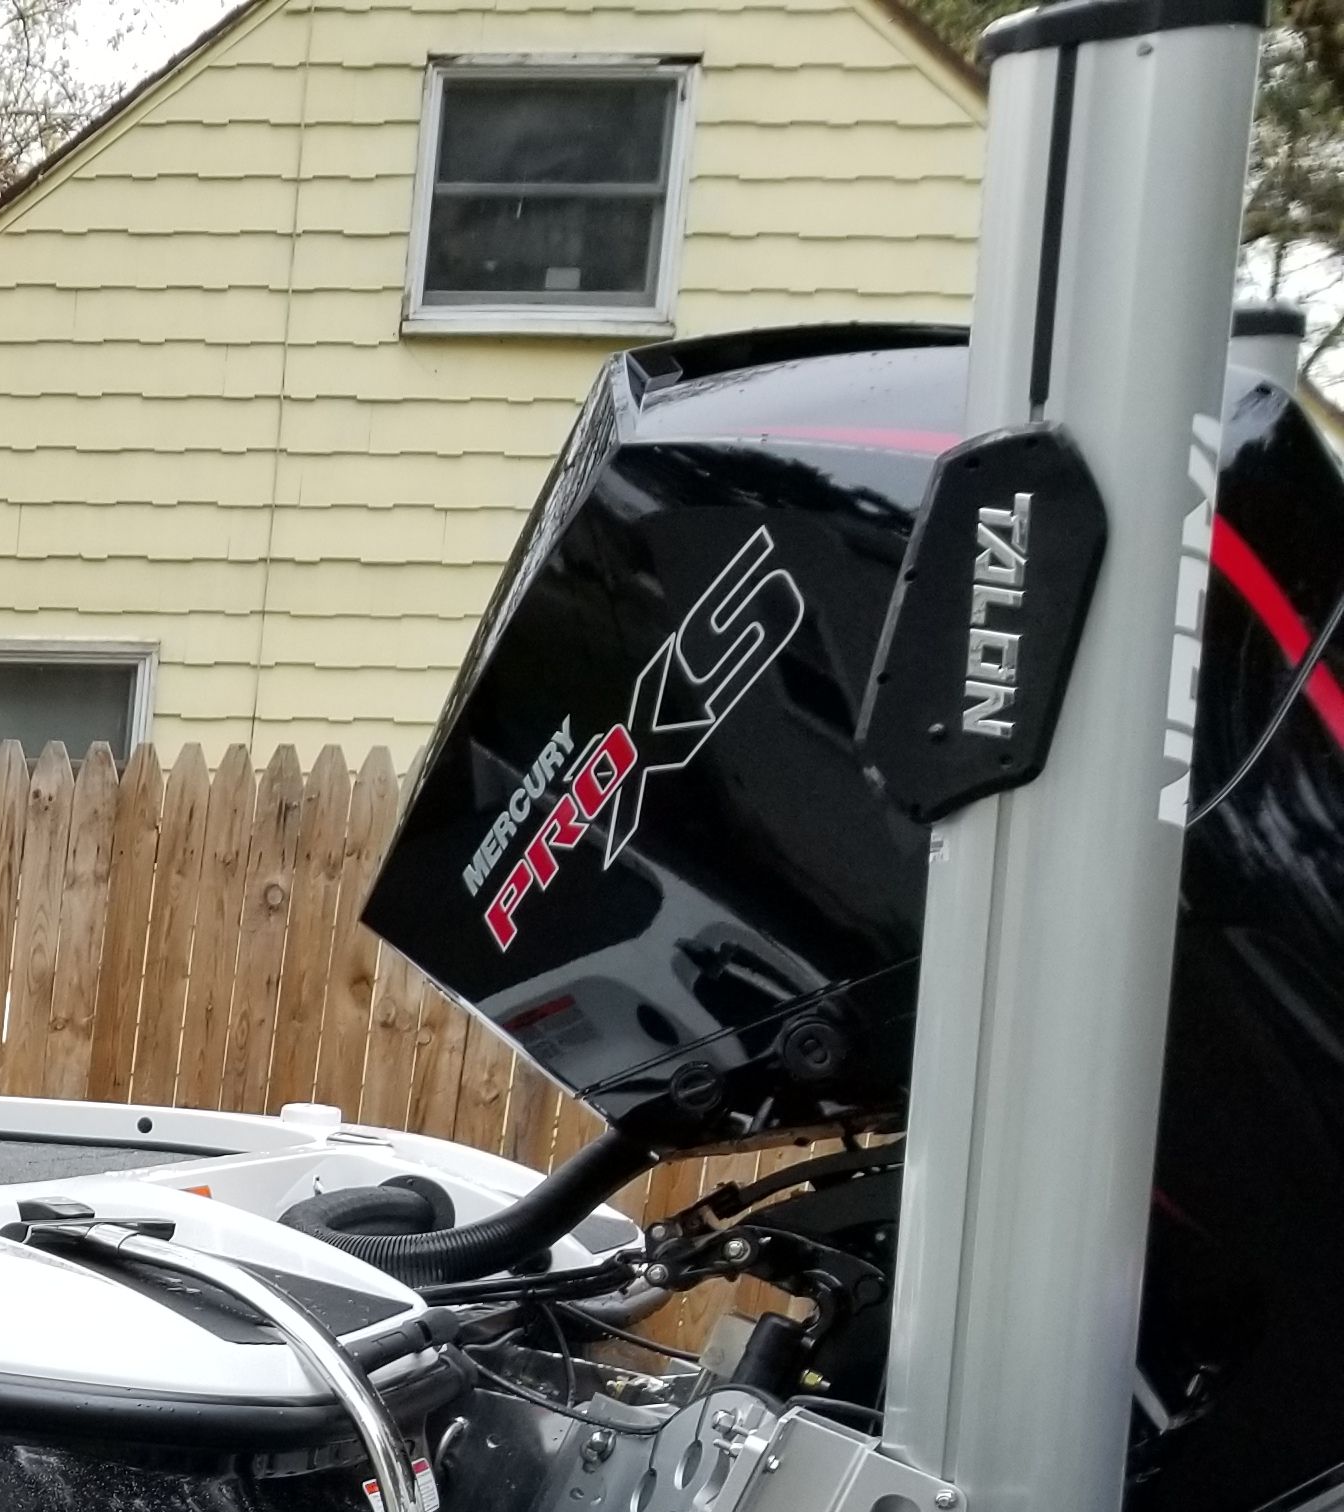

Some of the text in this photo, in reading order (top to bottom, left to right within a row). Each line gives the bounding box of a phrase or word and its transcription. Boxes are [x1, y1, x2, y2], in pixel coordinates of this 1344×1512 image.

[962, 493, 1035, 740] TALON
[461, 713, 577, 897] MERCURY
[484, 723, 639, 953] PRO
